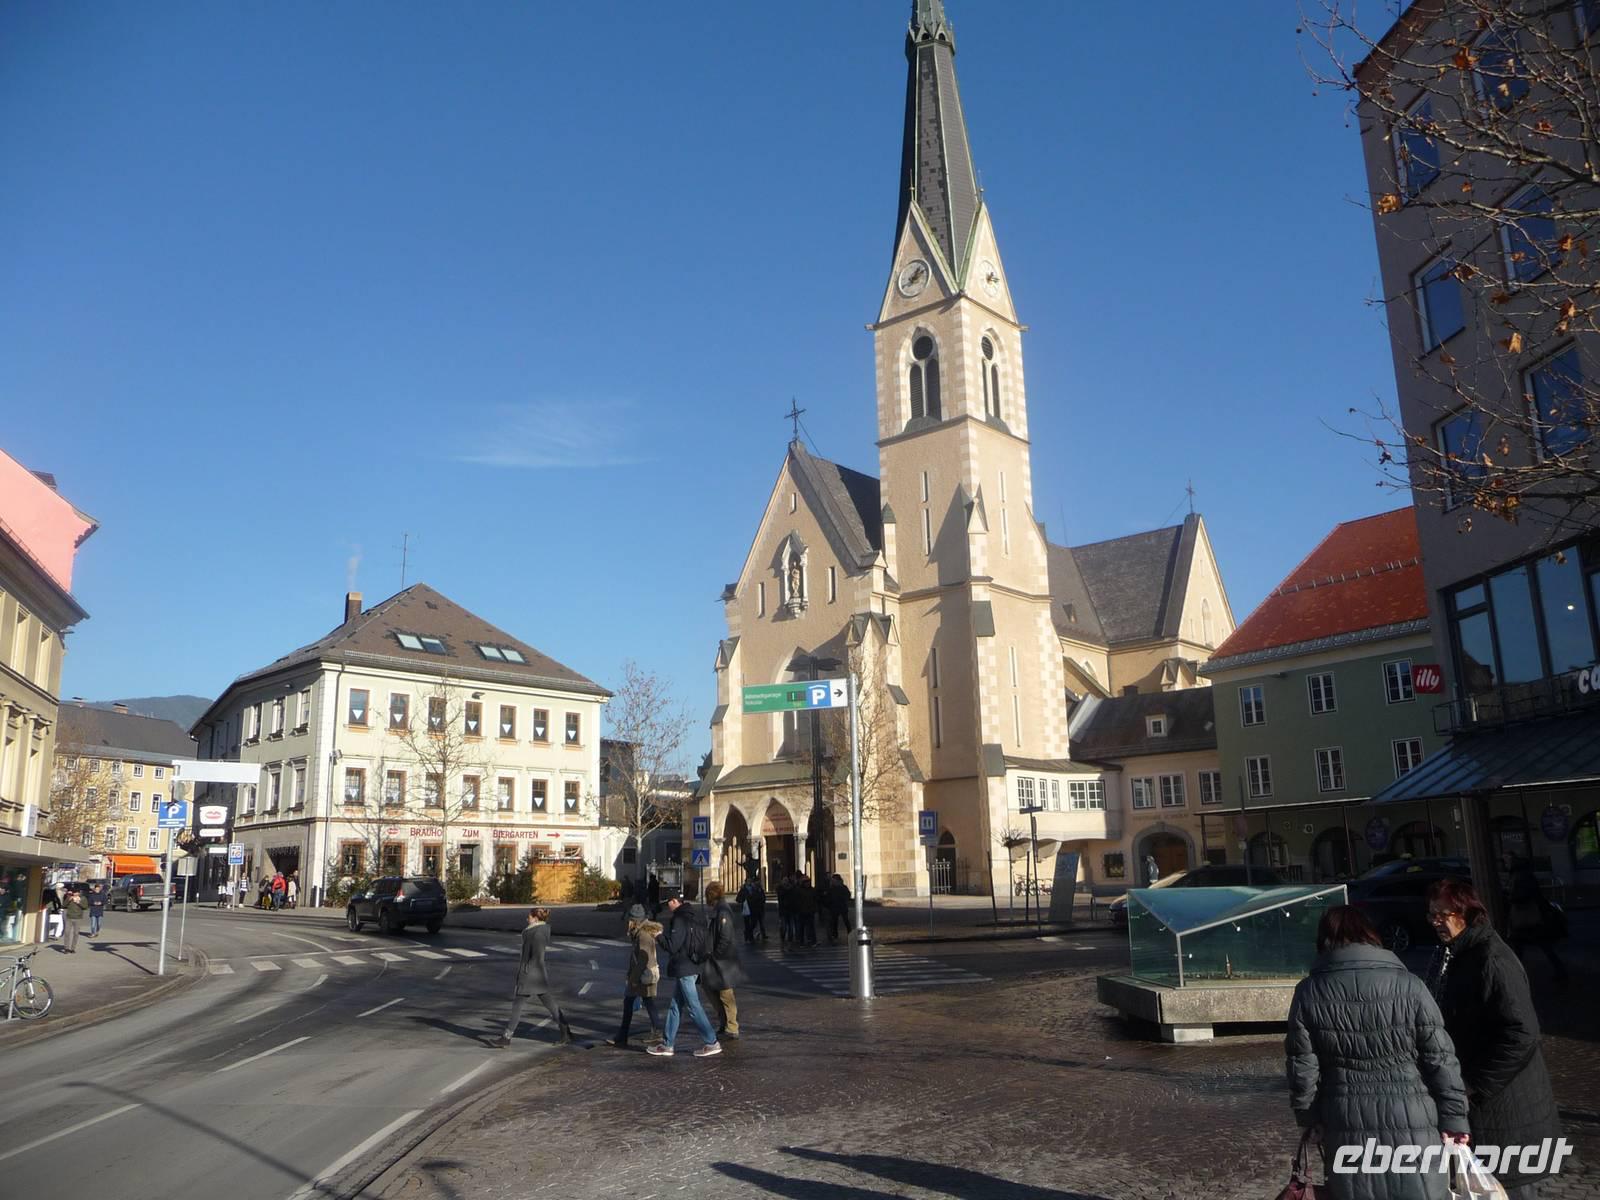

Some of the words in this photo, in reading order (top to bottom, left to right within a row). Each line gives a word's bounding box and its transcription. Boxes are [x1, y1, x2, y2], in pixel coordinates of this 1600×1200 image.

[1416, 669, 1440, 690] illy
[811, 688, 826, 705] P
[168, 806, 180, 819] P
[410, 827, 446, 837] BRAUHO
[462, 829, 480, 838] ZUM
[492, 829, 539, 839] BIERGARTEN
